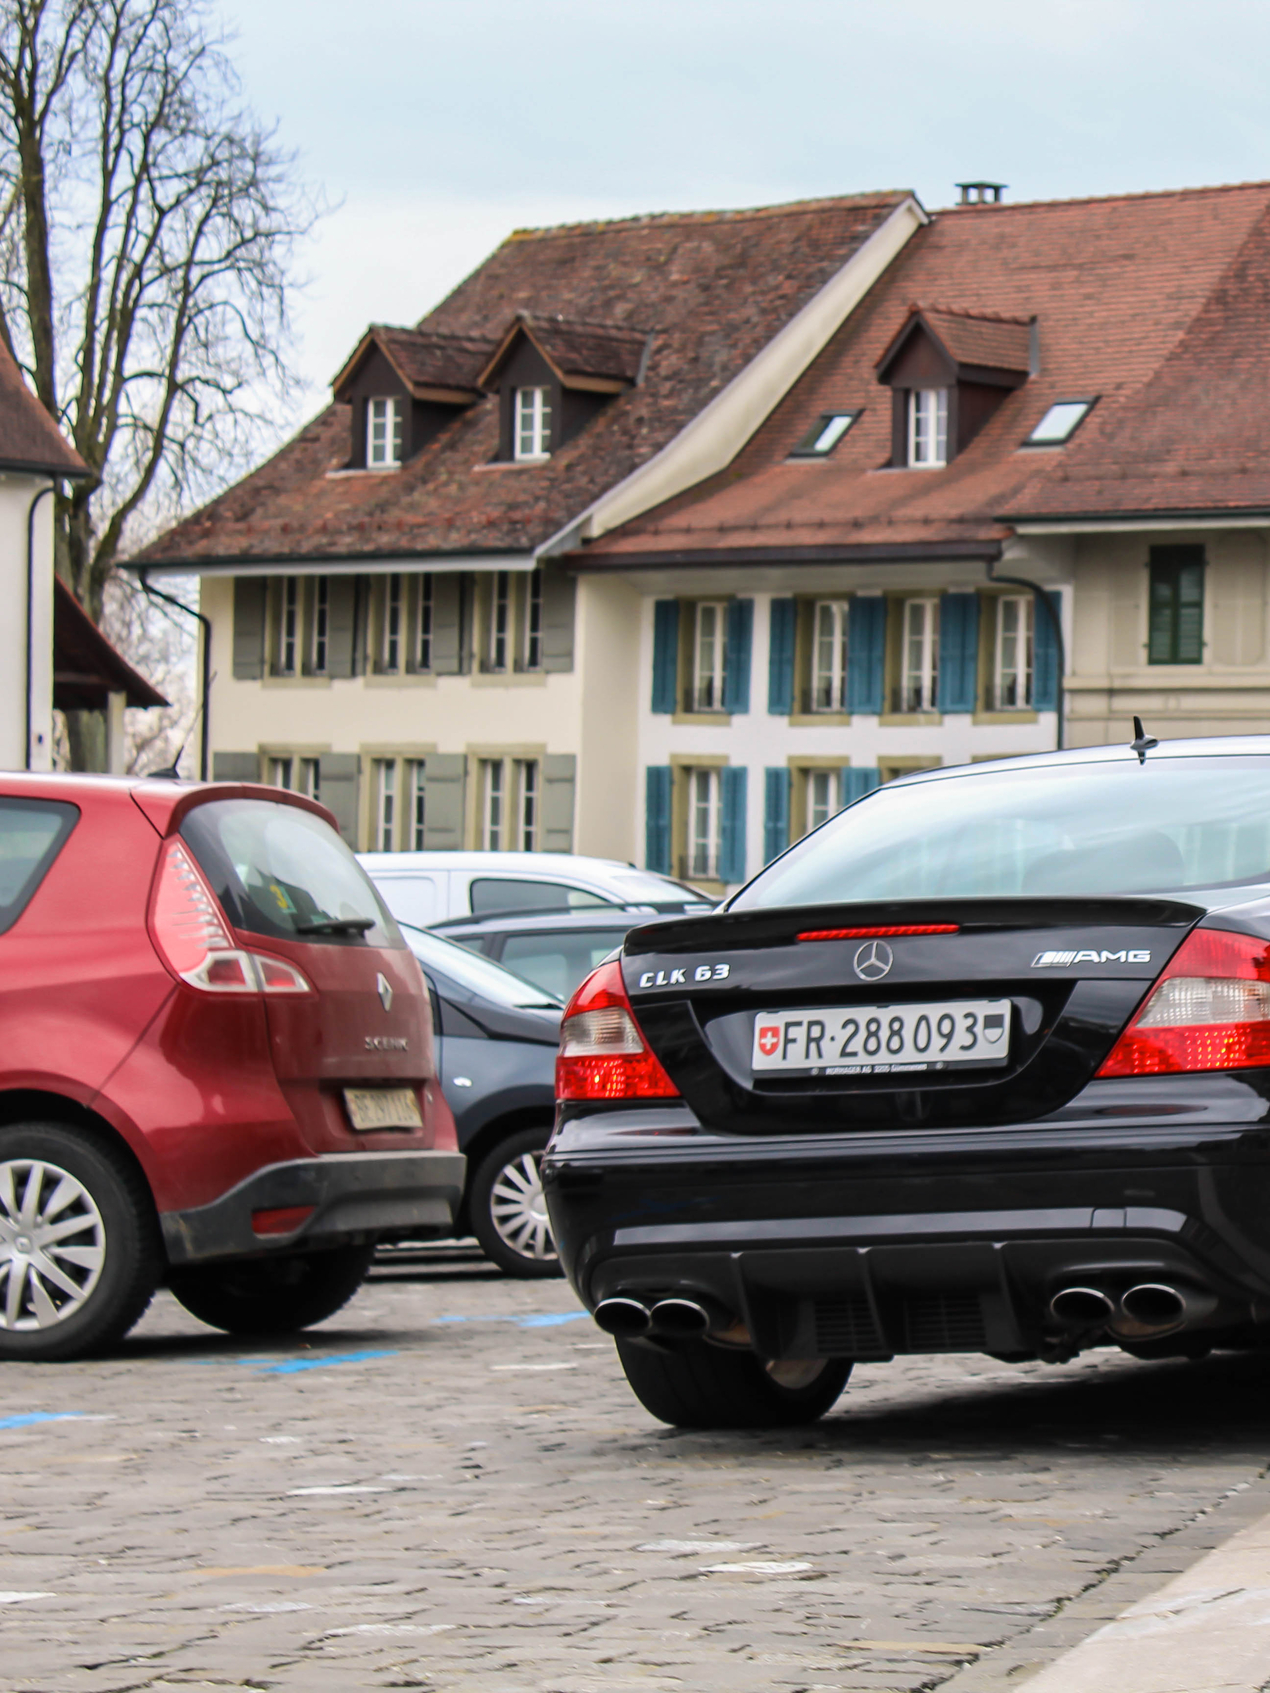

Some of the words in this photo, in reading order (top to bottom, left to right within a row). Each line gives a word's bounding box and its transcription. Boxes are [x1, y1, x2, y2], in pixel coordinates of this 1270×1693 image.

[1073, 950, 1151, 963] AMG
[639, 968, 687, 988] CLK
[694, 963, 731, 982] 63
